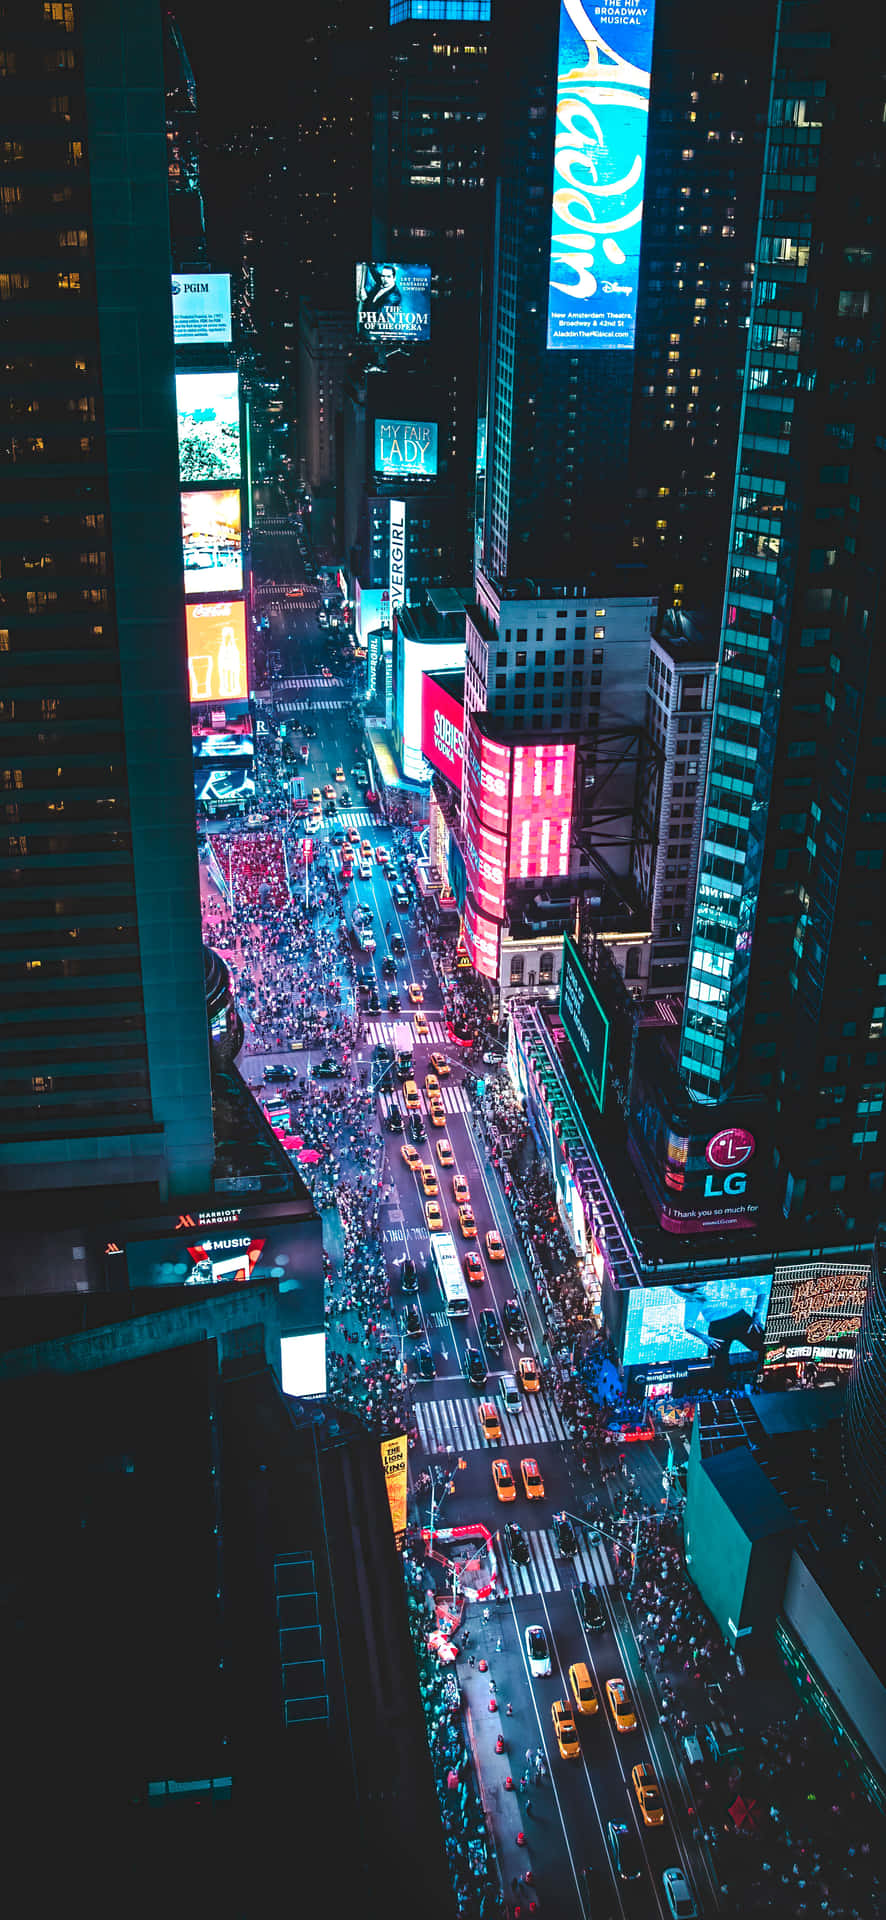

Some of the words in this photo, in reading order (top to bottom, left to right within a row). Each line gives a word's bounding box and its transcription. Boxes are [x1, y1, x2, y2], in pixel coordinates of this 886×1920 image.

[595, 7, 648, 16] BROADWAY
[600, 16, 641, 24] MUSICAL
[183, 283, 209, 293] PGIM
[384, 305, 402, 313] THE
[359, 311, 428, 325] PHANTOM
[364, 322, 376, 330] OF
[394, 323, 422, 331] OPERA
[381, 425, 401, 439] MY
[404, 426, 431, 441] FAIR
[380, 438, 430, 464] LADY
[434, 735, 455, 764] VODKA
[704, 1172, 747, 1197] LG
[199, 1209, 242, 1219] MARRIOTT
[673, 1209, 697, 1218] Thank
[697, 1209, 712, 1218] you
[724, 1205, 746, 1214] much
[747, 1204, 759, 1212] for
[199, 1215, 238, 1225] MARQUIS
[213, 1237, 251, 1250] MUSIC
[785, 1346, 812, 1359] SERVED
[812, 1346, 838, 1359] FAMILY
[387, 1445, 401, 1456] THE
[384, 1452, 403, 1465] LION
